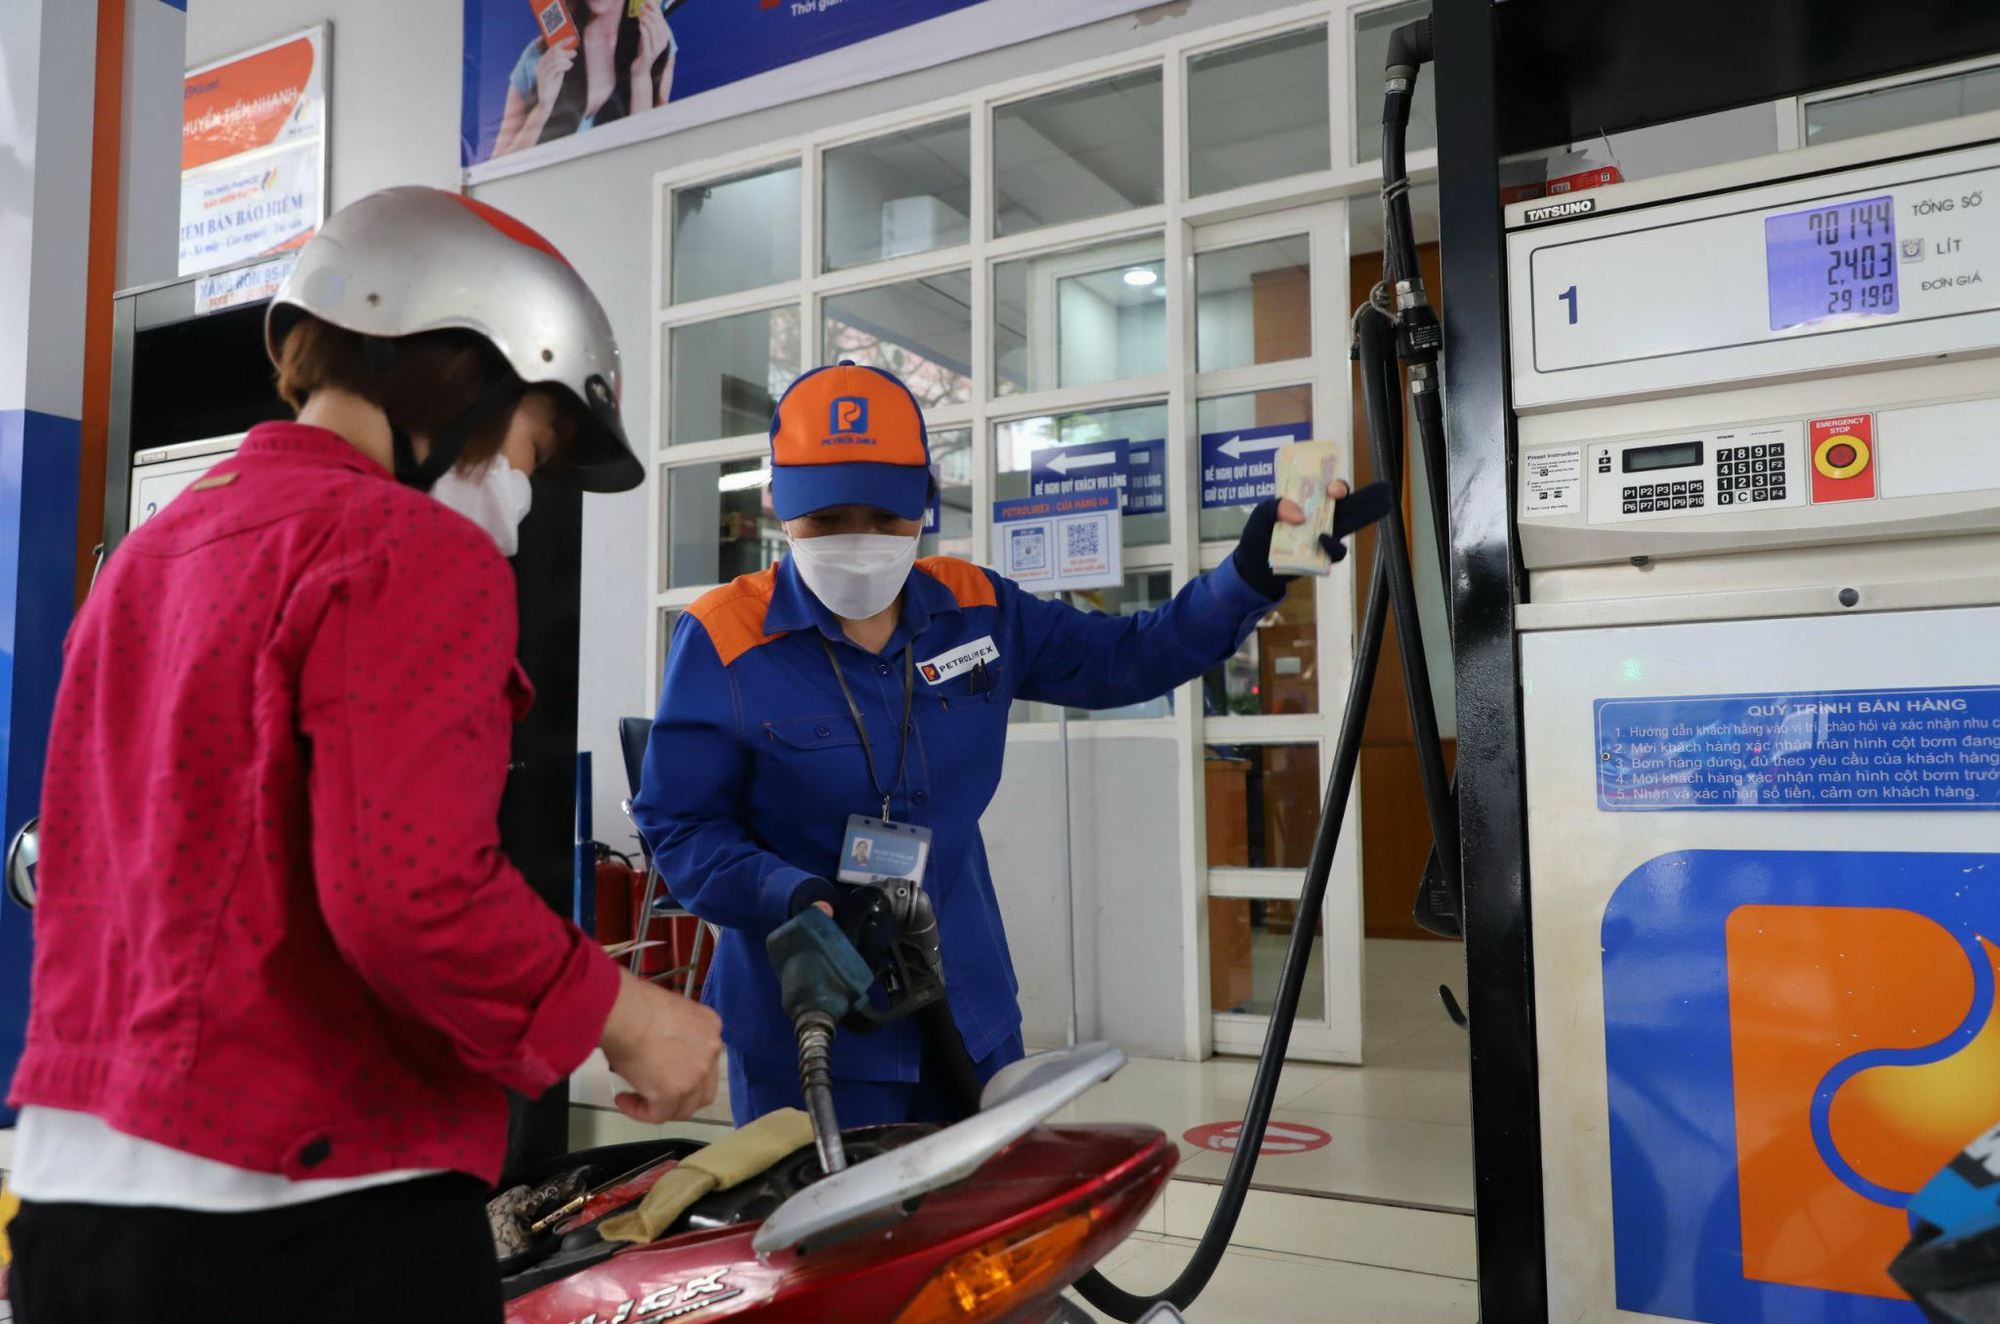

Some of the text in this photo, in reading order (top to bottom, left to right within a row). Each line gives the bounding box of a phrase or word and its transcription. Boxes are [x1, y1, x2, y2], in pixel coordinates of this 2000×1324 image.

[252, 86, 298, 113] NHANH
[1527, 200, 1592, 221] TATSUNO
[1912, 191, 1984, 217] TỔNG SỐ
[1809, 201, 1891, 246] 70144
[1937, 238, 1962, 255] LÍT
[1827, 243, 1893, 286] 2,403
[1921, 272, 1983, 292] ĐƠN GIÁ
[1558, 285, 1578, 325] 1
[1828, 283, 1894, 315] 29190
[1816, 417, 1865, 429] EMERGENCY
[1830, 426, 1851, 434] STOP
[1722, 446, 1782, 460] 7 8 9 F1
[1721, 461, 1783, 474] 4 5 6 F2
[1624, 483, 1702, 497] P1 P2 P3 P4 P5
[1722, 475, 1783, 488] 1 2 3 F3
[1624, 497, 1703, 512] P6 P7 P8 P9 P10
[1721, 489, 1783, 503] 0 C F4
[939, 645, 993, 673] PETROLIMEX
[1747, 696, 1968, 717] QUY TRÌNH BÁN HÀNG
[1615, 727, 1626, 738] 1.
[1630, 725, 1668, 739] Hướng
[1672, 722, 1693, 737] dẫn
[1696, 722, 1731, 736] khách
[1734, 722, 1763, 738] hàng
[1766, 722, 1788, 734] vào
[1826, 719, 1855, 732] chào
[1859, 718, 1878, 732] hỏi
[1881, 719, 1897, 731] và
[1901, 718, 1924, 731] xác
[1927, 717, 1960, 732] nhận
[1964, 717, 1988, 730] nhu
[1615, 743, 1626, 754] 2.
[1631, 741, 1657, 753] Mời
[1661, 740, 1700, 753] khách
[1706, 740, 1741, 755] hàng
[1745, 739, 1771, 752] xác
[1816, 738, 1849, 751] màn
[1854, 736, 1888, 749] hình
[1891, 736, 1916, 750] cột
[1920, 736, 1957, 749] bơm
[1615, 758, 1626, 770] 3.
[1632, 757, 1663, 768] Bơm
[1668, 756, 1703, 770] hàng
[1750, 754, 1769, 767] đủ
[1772, 754, 1806, 767] theo
[1810, 753, 1837, 768] yêu
[1841, 752, 1869, 766] cầu
[1873, 752, 1902, 765] của
[1907, 751, 1954, 765] khách
[1615, 774, 1626, 785] 4.
[1633, 771, 1658, 784] Mời
[1662, 771, 1703, 784] khách
[1708, 771, 1743, 786] hàng
[1747, 771, 1773, 783] xác
[1777, 770, 1813, 785] nhận
[1819, 769, 1851, 782] màn
[1856, 769, 1889, 782] hình
[1894, 769, 1919, 784] cột
[1923, 768, 1960, 781] bơm
[1616, 789, 1628, 800] 5.
[1633, 787, 1669, 801] Nhận
[1673, 788, 1690, 799] và
[1694, 787, 1719, 799] xác
[1722, 786, 1758, 801] nhận
[1763, 784, 1780, 799] số
[1820, 784, 1852, 798] cảm
[1856, 786, 1878, 798] ơn
[1882, 784, 1930, 798] khách
[1934, 784, 1980, 800] hàng.
